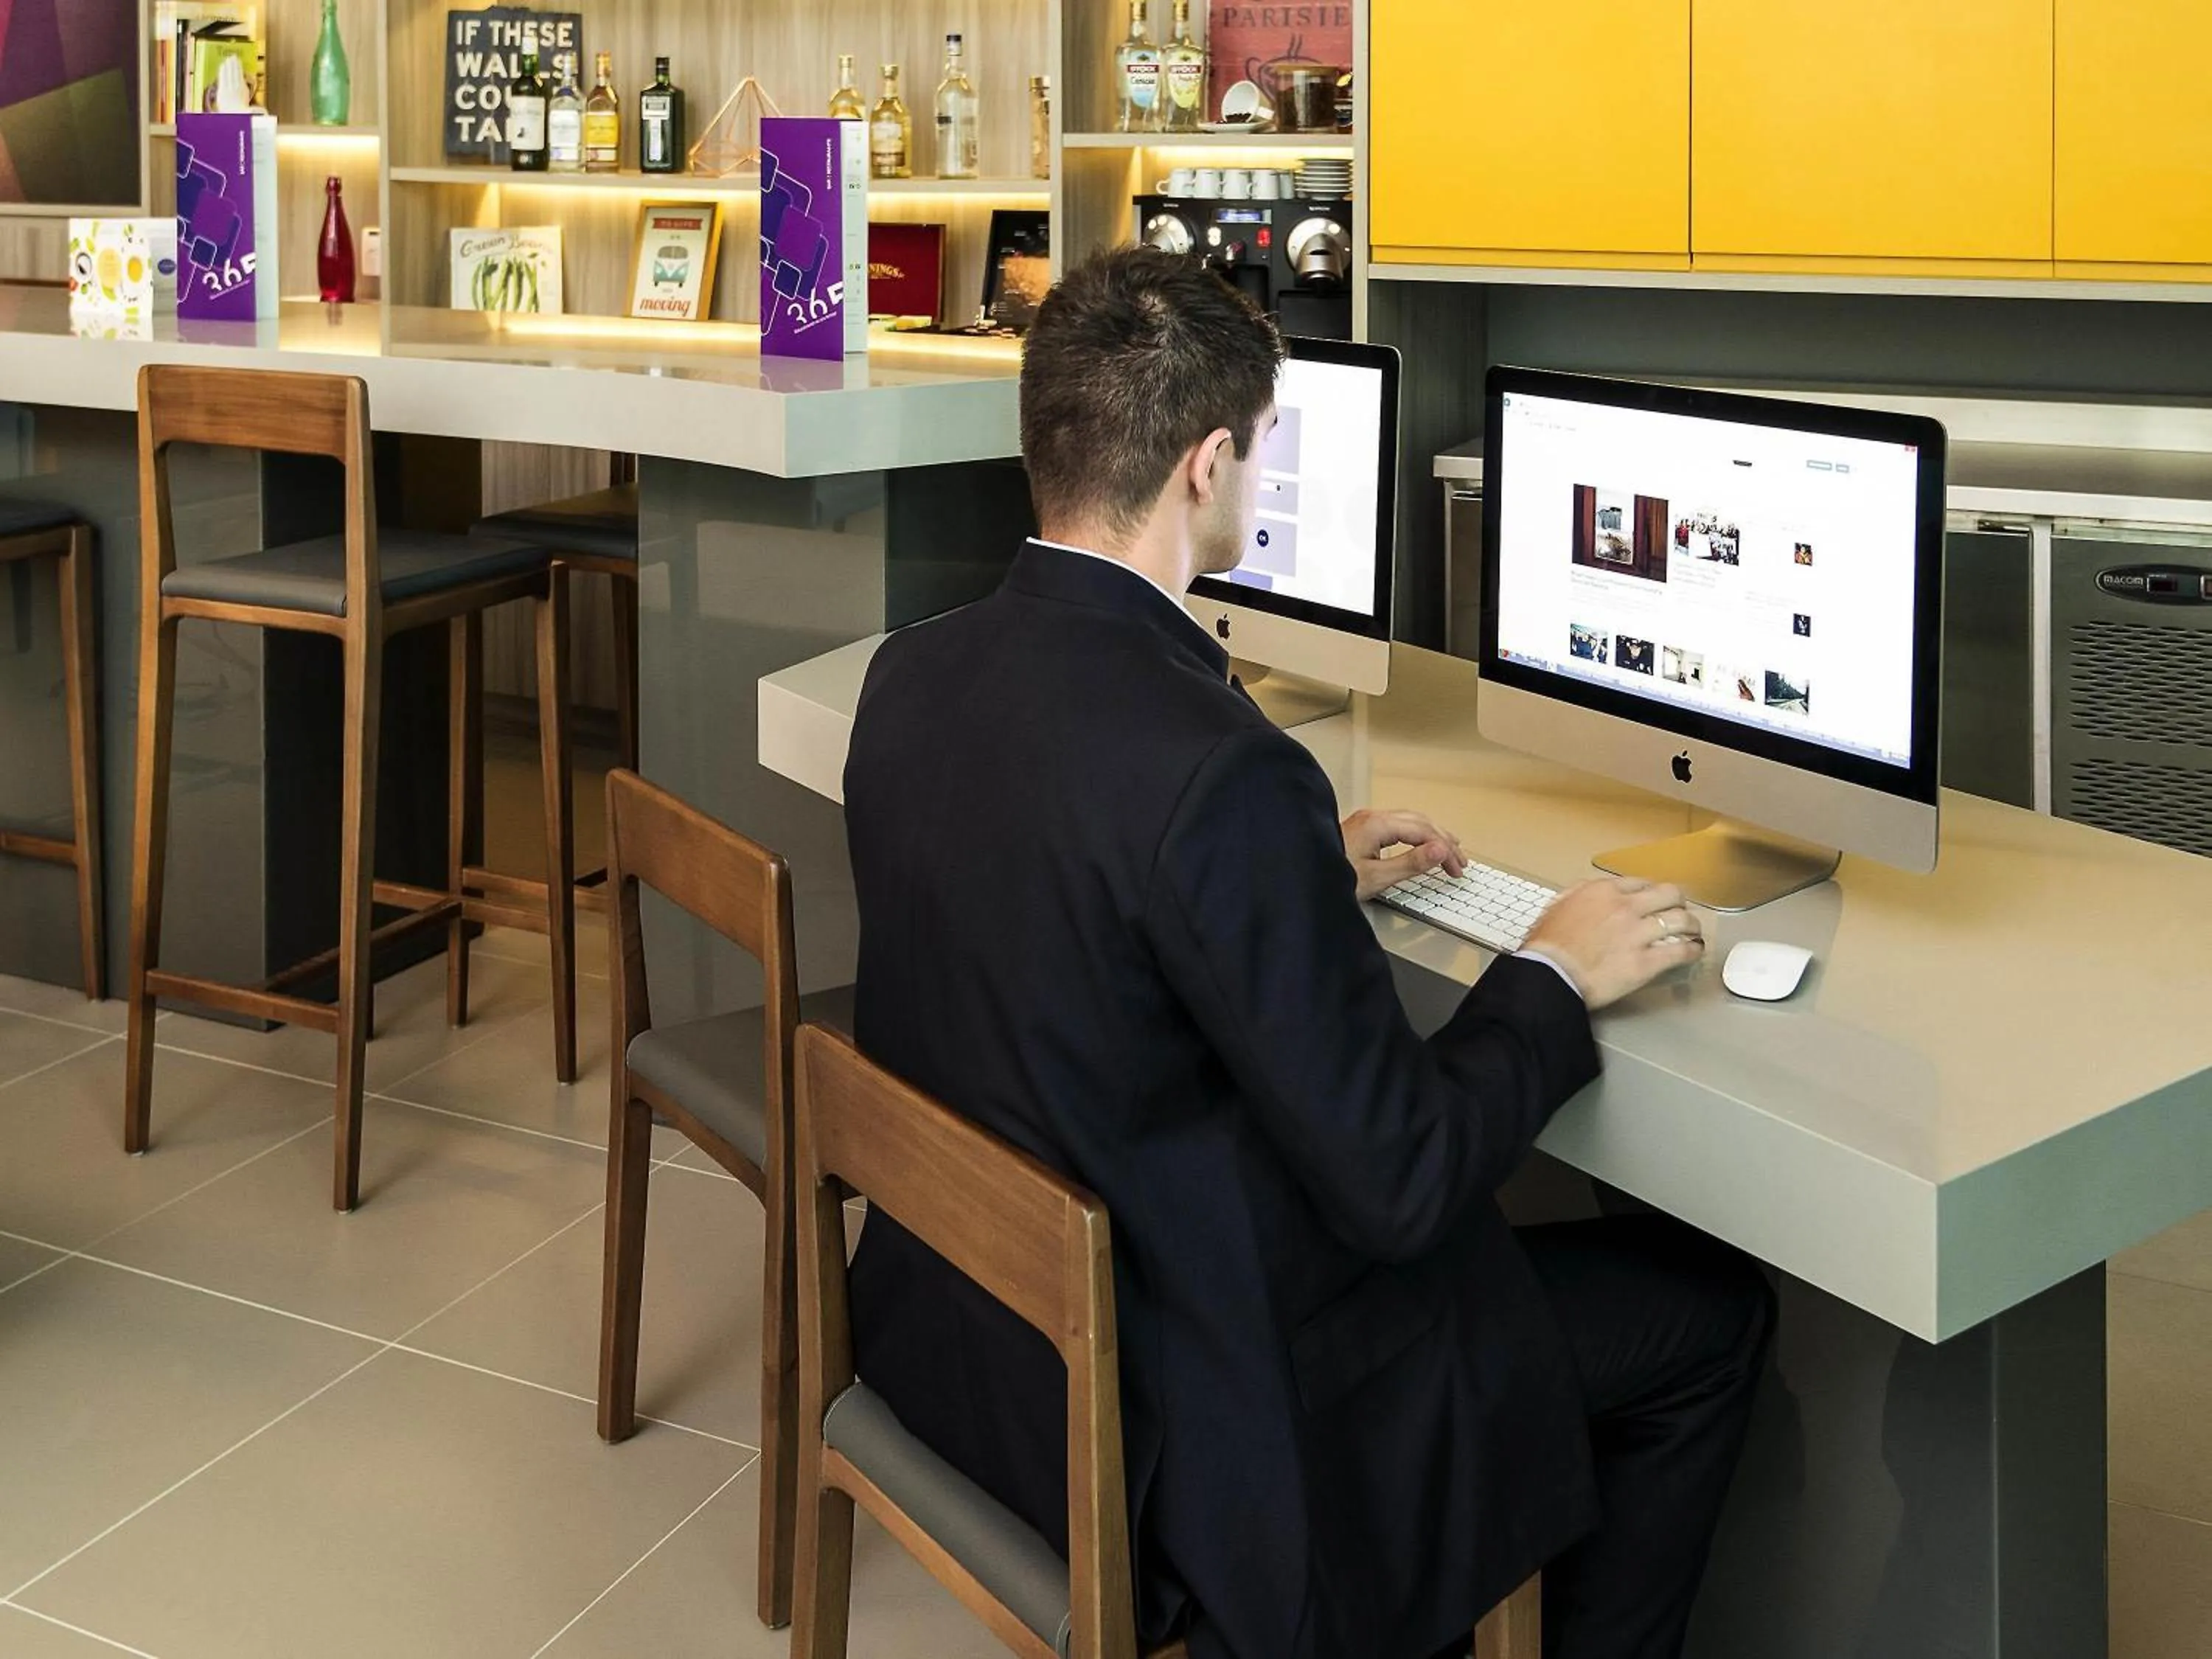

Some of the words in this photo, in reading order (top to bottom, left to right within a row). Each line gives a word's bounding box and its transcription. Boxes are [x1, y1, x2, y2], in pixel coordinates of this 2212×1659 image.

[1224, 7, 1351, 27] PARISIE
[456, 20, 481, 46] IF
[489, 21, 573, 47] THESE
[639, 296, 691, 318] moving
[787, 281, 844, 324] 365
